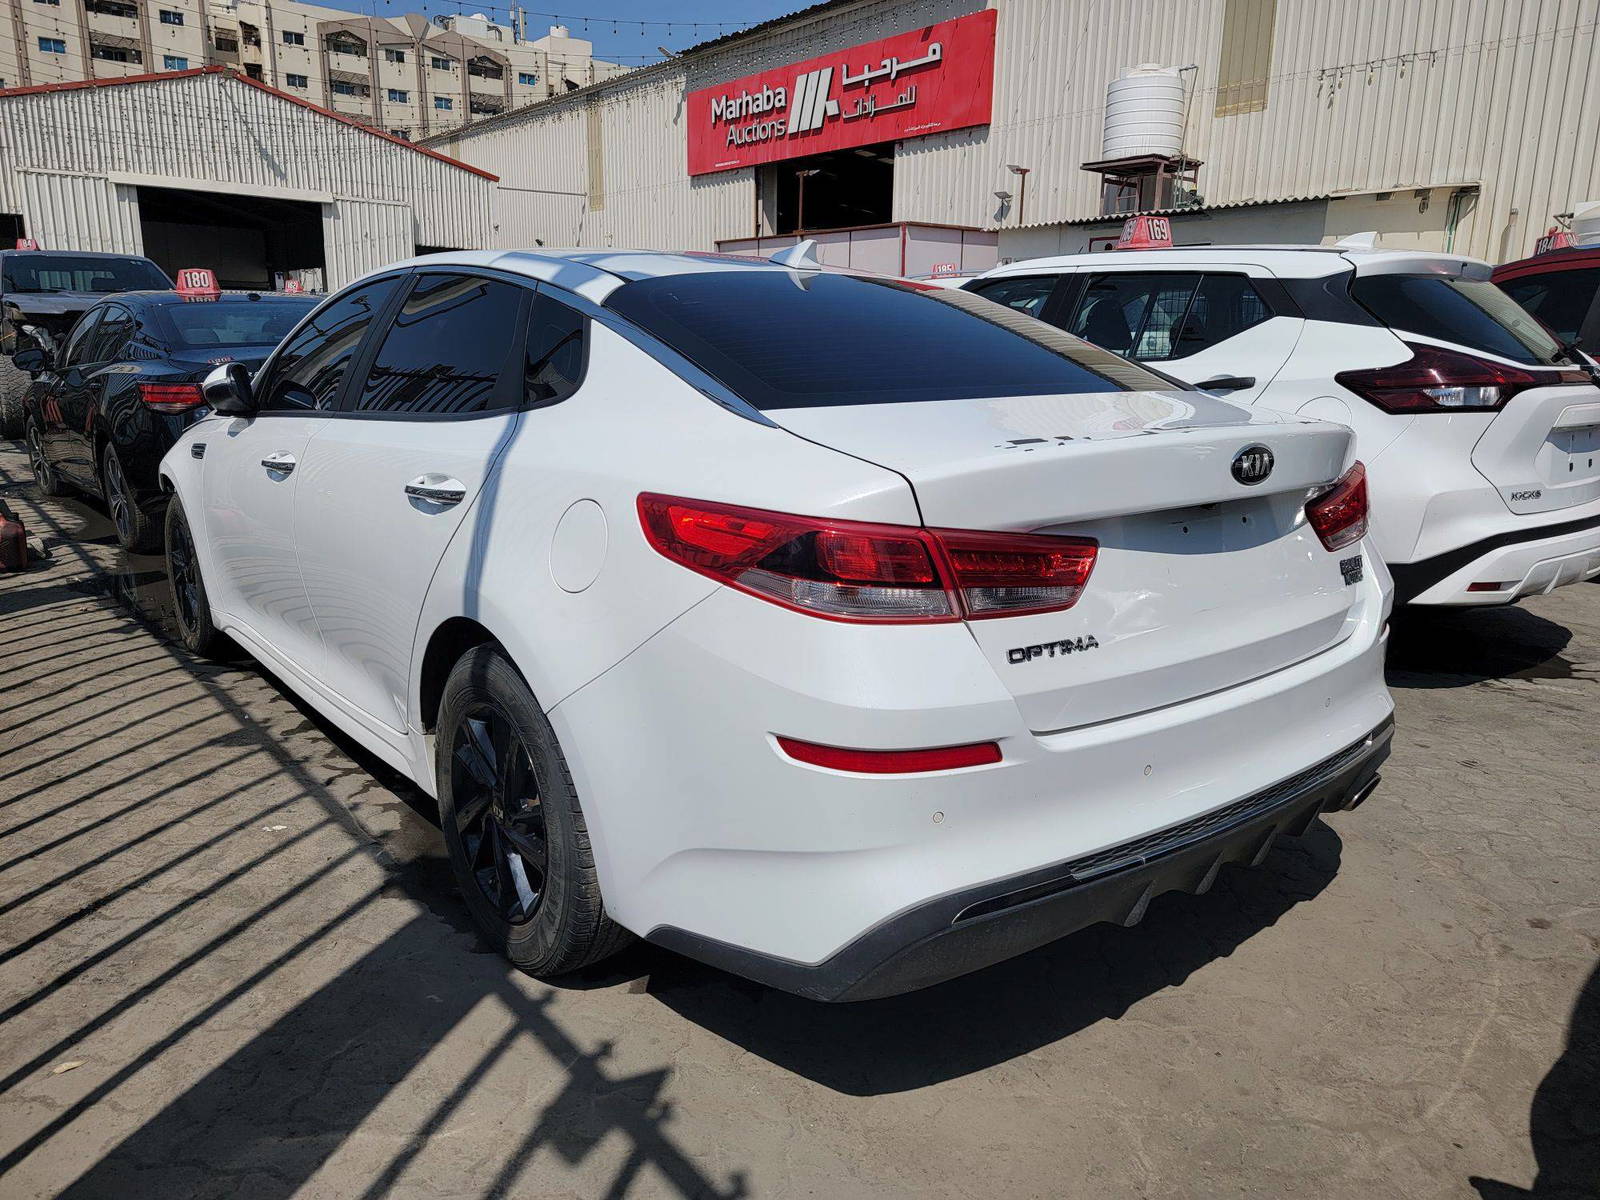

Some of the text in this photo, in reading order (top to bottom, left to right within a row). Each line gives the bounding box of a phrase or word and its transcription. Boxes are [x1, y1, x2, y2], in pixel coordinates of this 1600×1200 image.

[842, 42, 942, 87] مرحبا
[711, 84, 786, 124] Marhaba
[842, 85, 916, 119] للمزادات
[726, 119, 786, 148] Auctions
[1148, 218, 1168, 240] 169
[185, 271, 209, 288] 180
[1241, 453, 1270, 477] KIA
[1006, 634, 1099, 664] OPTIMA
